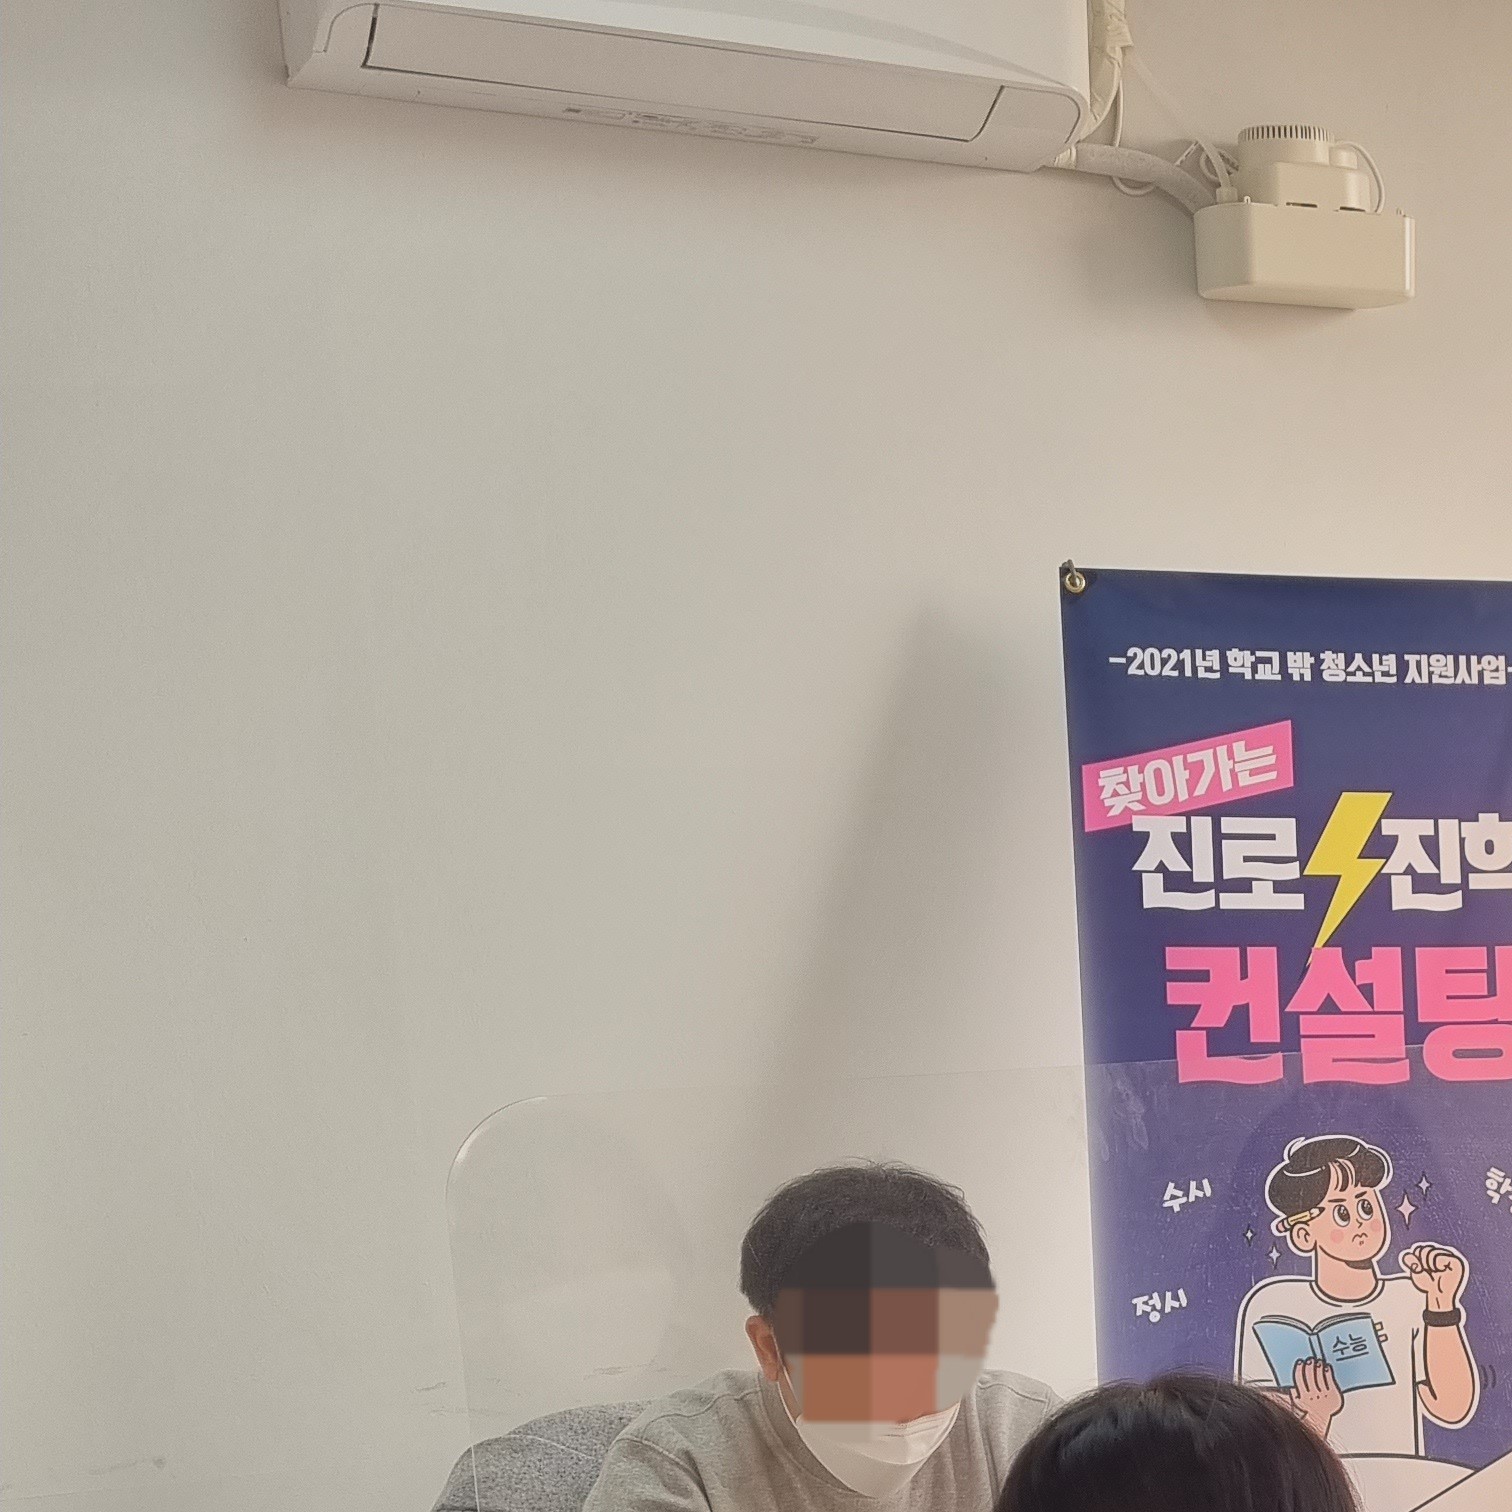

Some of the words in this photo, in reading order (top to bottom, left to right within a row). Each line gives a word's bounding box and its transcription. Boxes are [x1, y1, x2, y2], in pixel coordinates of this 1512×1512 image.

[1226, 648, 1282, 681] 학교
[1286, 651, 1315, 682] 밖
[1319, 650, 1398, 683] 청소년
[1098, 740, 1278, 817] 찾아가는
[1131, 815, 1306, 911] 진로
[1161, 1177, 1213, 1214] 수시
[1131, 1287, 1189, 1323] 정시
[1332, 1333, 1368, 1356] 수능
